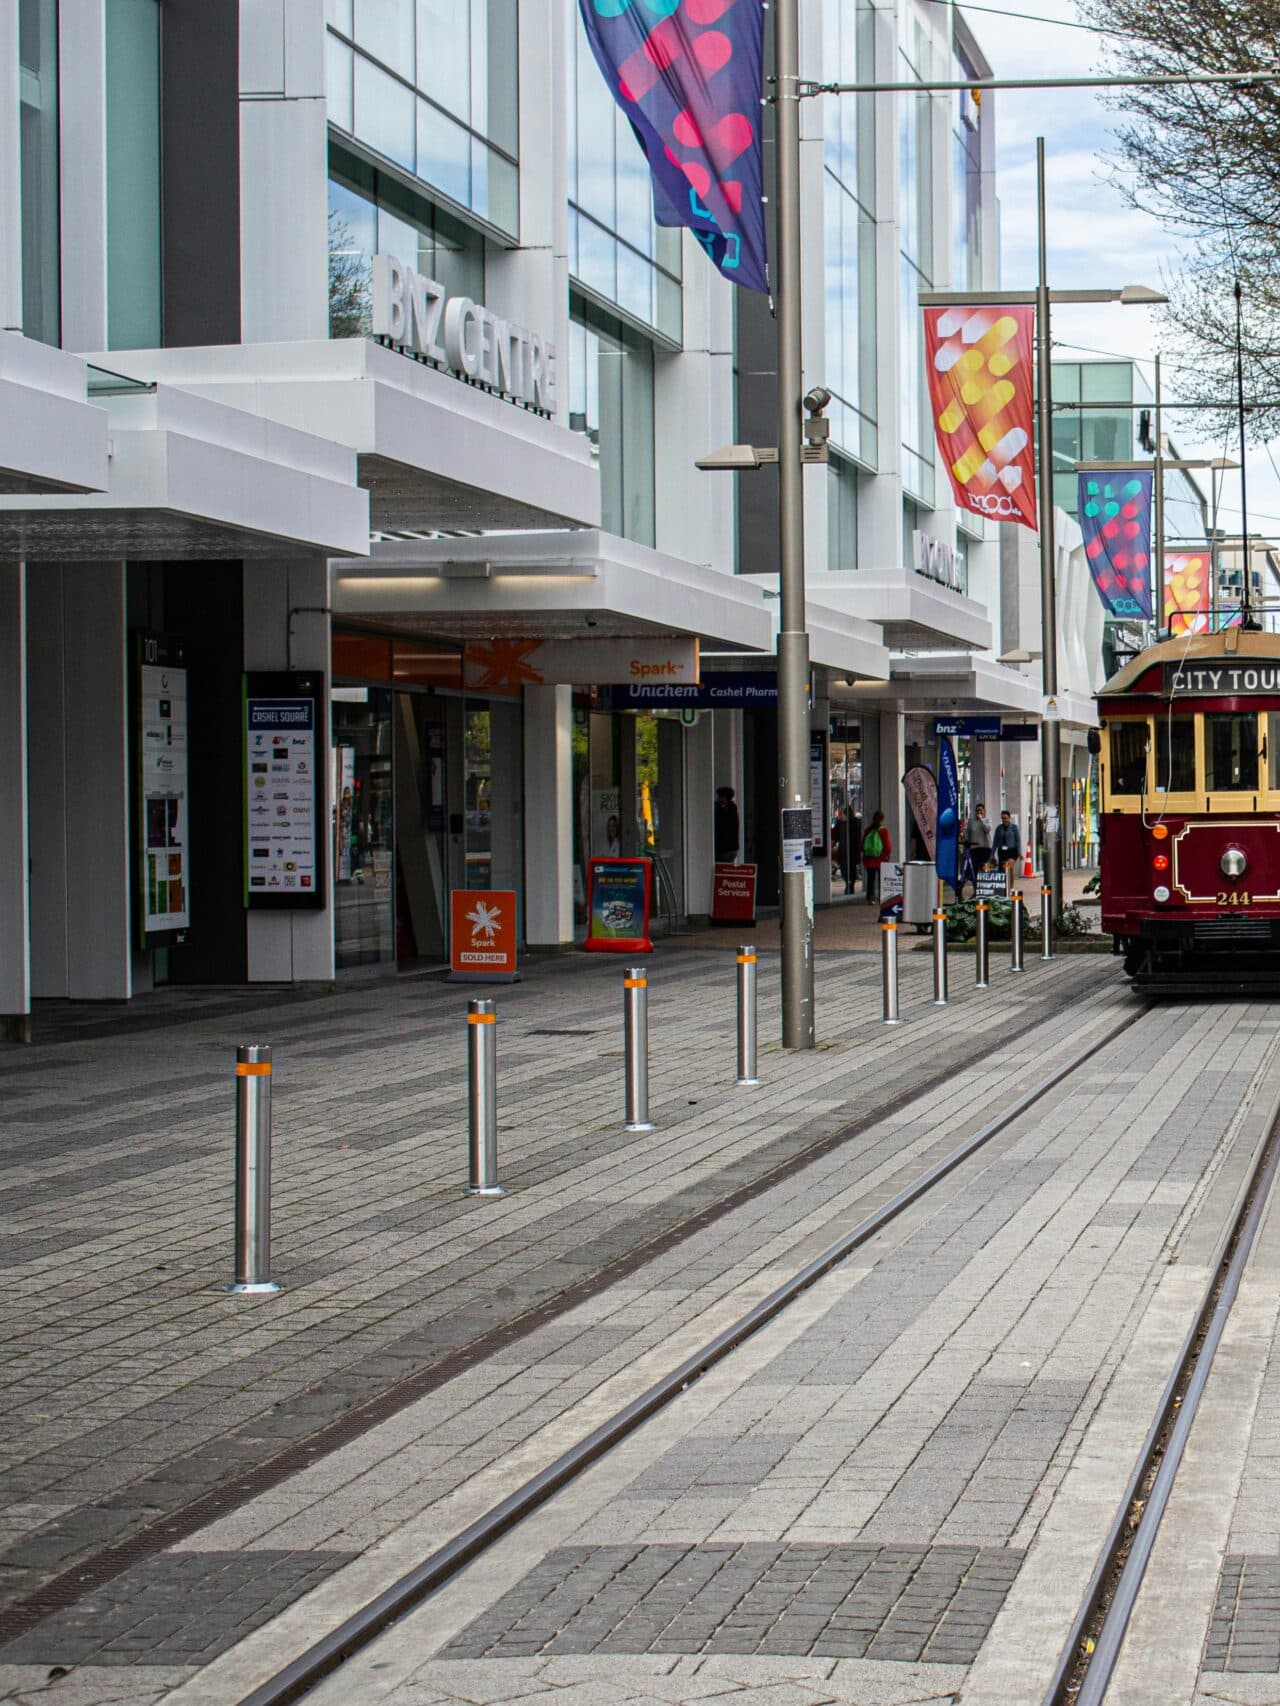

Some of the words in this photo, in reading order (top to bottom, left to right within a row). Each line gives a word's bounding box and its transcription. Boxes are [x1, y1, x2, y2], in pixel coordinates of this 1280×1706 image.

[629, 659, 676, 677] Spark
[1172, 670, 1222, 690] CITY
[629, 684, 699, 697] Unichem
[710, 687, 743, 697] Cashel
[252, 711, 279, 722] CASHEL
[280, 711, 309, 722] SQUARE
[936, 723, 957, 734] bnz
[722, 879, 746, 889] Postal
[718, 888, 750, 897] Services
[1217, 891, 1250, 905] 244
[471, 938, 496, 948] Spark
